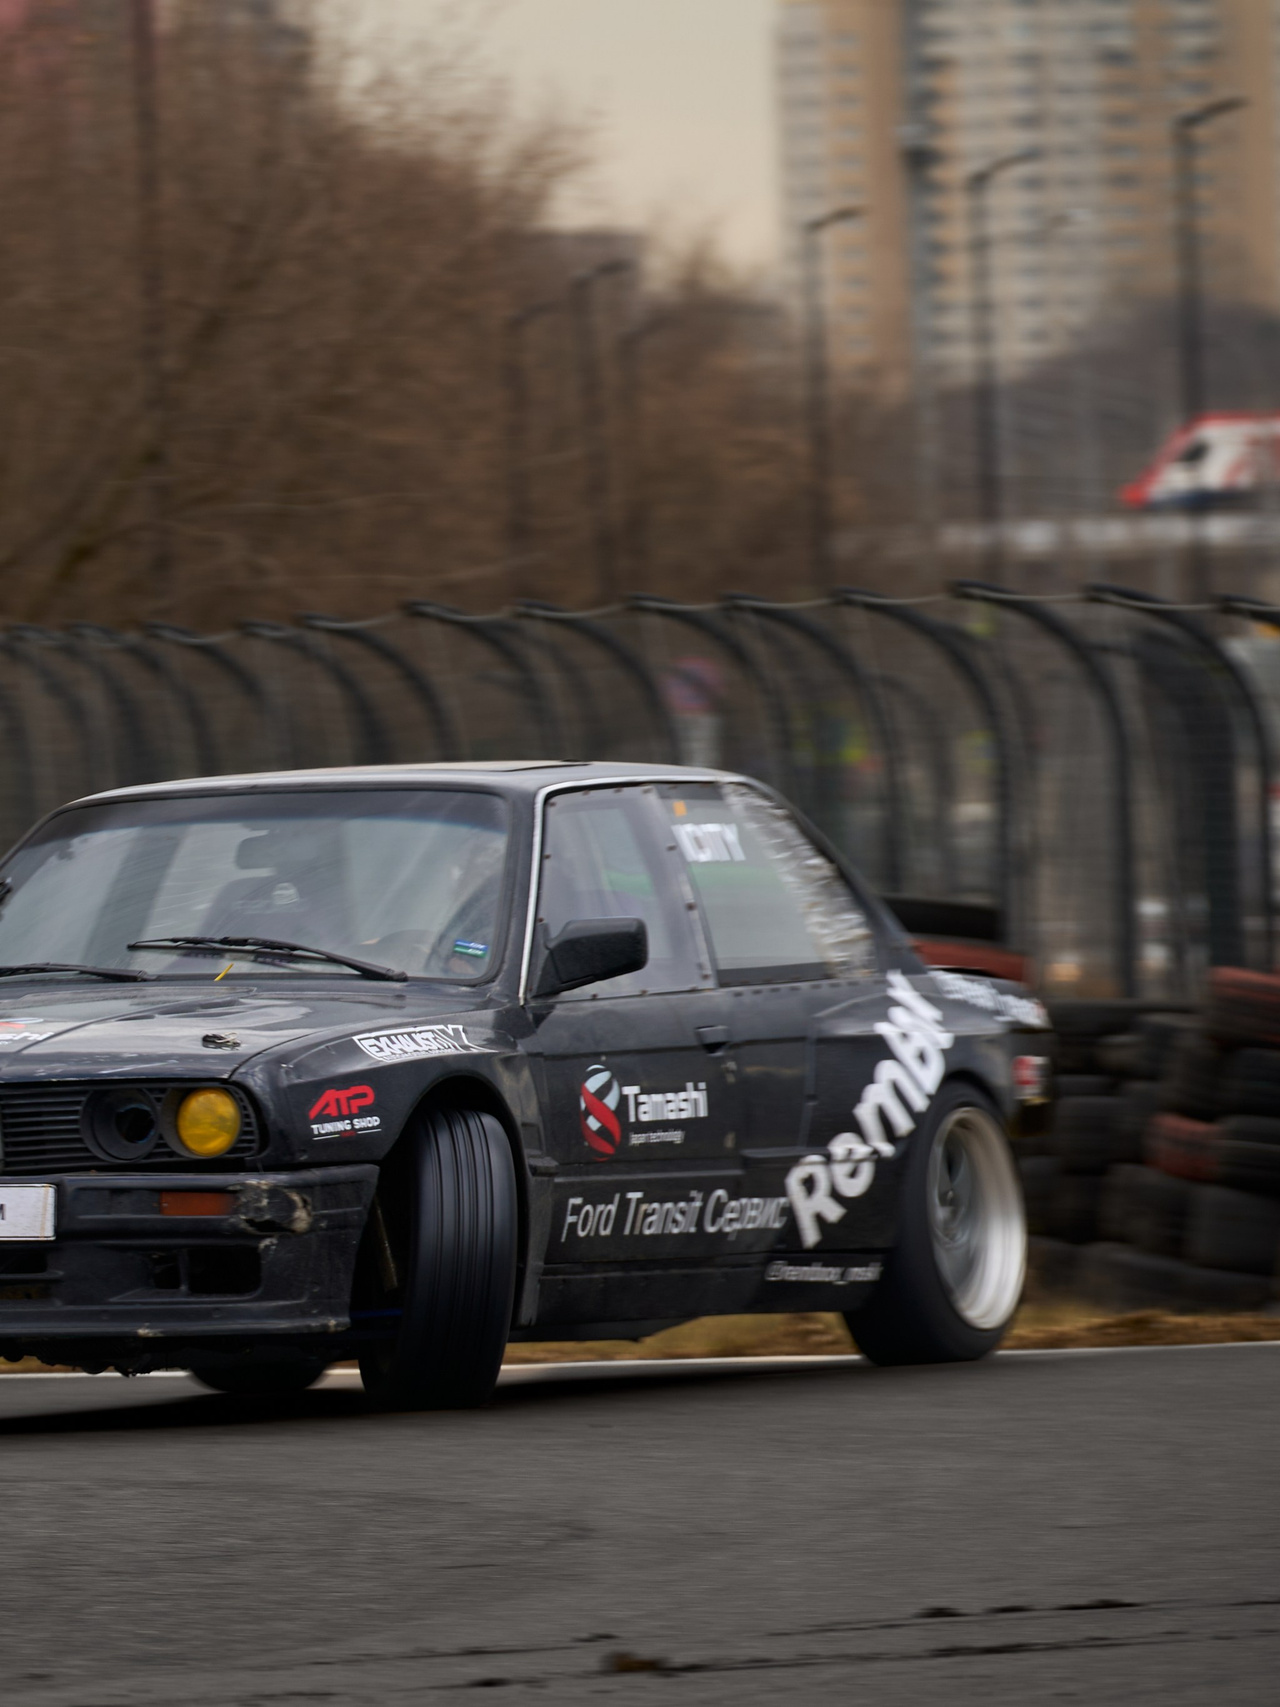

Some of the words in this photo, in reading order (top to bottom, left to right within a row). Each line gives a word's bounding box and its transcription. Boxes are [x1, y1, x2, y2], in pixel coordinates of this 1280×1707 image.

[361, 1031, 442, 1057] EXHAUST
[308, 1085, 375, 1120] ATP
[621, 1082, 708, 1122] Tamashi
[310, 1120, 352, 1134] TUNING
[352, 1116, 381, 1129] SHOP
[561, 1193, 620, 1242] Ford
[623, 1190, 703, 1235] Transit
